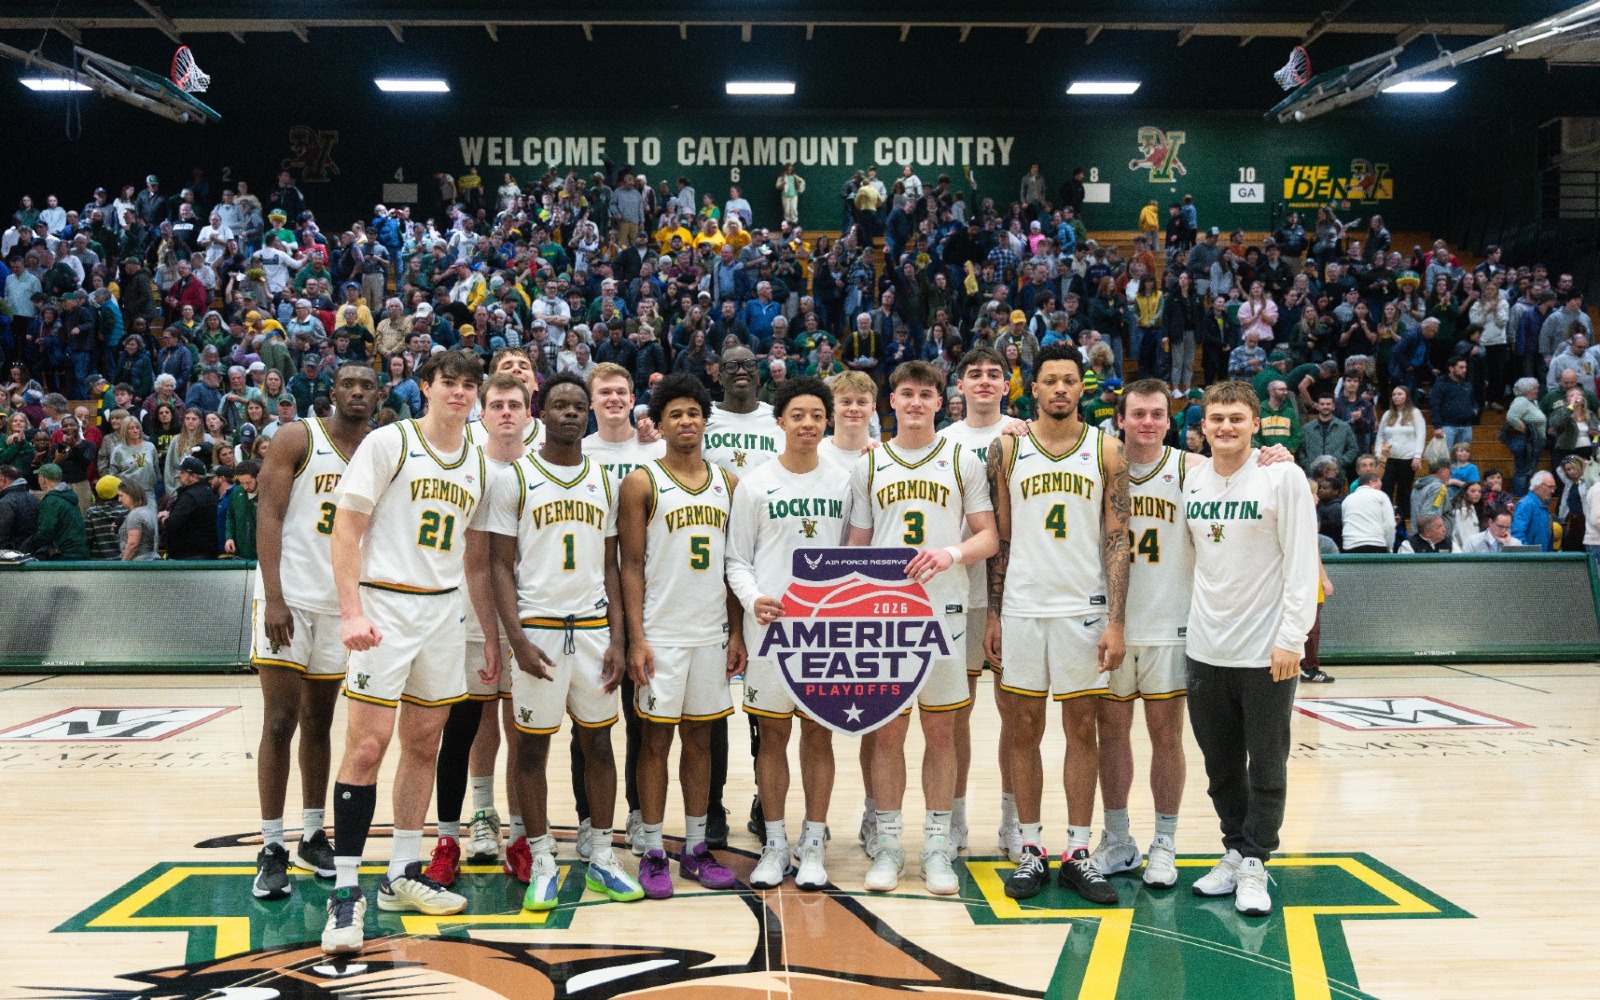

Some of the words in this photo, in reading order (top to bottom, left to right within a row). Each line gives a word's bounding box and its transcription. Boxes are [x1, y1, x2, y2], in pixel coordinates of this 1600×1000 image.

[459, 136, 607, 167] WELCOME
[623, 136, 662, 167] TO
[677, 136, 859, 167] CATAMOUNT
[874, 136, 1015, 167] COUNTRY
[221, 166, 232, 183] 2
[393, 166, 405, 183] 4
[730, 167, 741, 184] 6
[1089, 167, 1099, 183] 8
[1238, 167, 1256, 183] 10
[1290, 165, 1330, 180] THE
[1237, 187, 1257, 199] GA
[1292, 178, 1350, 200] DEN
[703, 433, 742, 450] LOCK
[744, 433, 758, 450] IT
[760, 435, 778, 453] IN.
[410, 478, 475, 518] VERMONT
[876, 479, 951, 511] VERMONT
[1020, 472, 1095, 501] VERMONT
[532, 499, 605, 531] VERMONT
[664, 505, 728, 534] VERMONT
[768, 498, 811, 520] LOCK
[813, 498, 826, 516] IT
[828, 498, 843, 519] IN.
[1044, 503, 1067, 539] 4
[1129, 495, 1177, 525] MONT
[1186, 501, 1222, 520] LOCK
[1223, 501, 1239, 520] IT
[1238, 500, 1263, 520] IN.
[417, 509, 455, 553] 21
[902, 510, 926, 546] 3
[562, 533, 576, 571] 1
[690, 535, 711, 571] 5
[873, 602, 908, 614] 2026
[758, 620, 951, 657] AMERICA
[801, 651, 908, 679] EAST
[805, 684, 901, 696] PLAYOFFS
